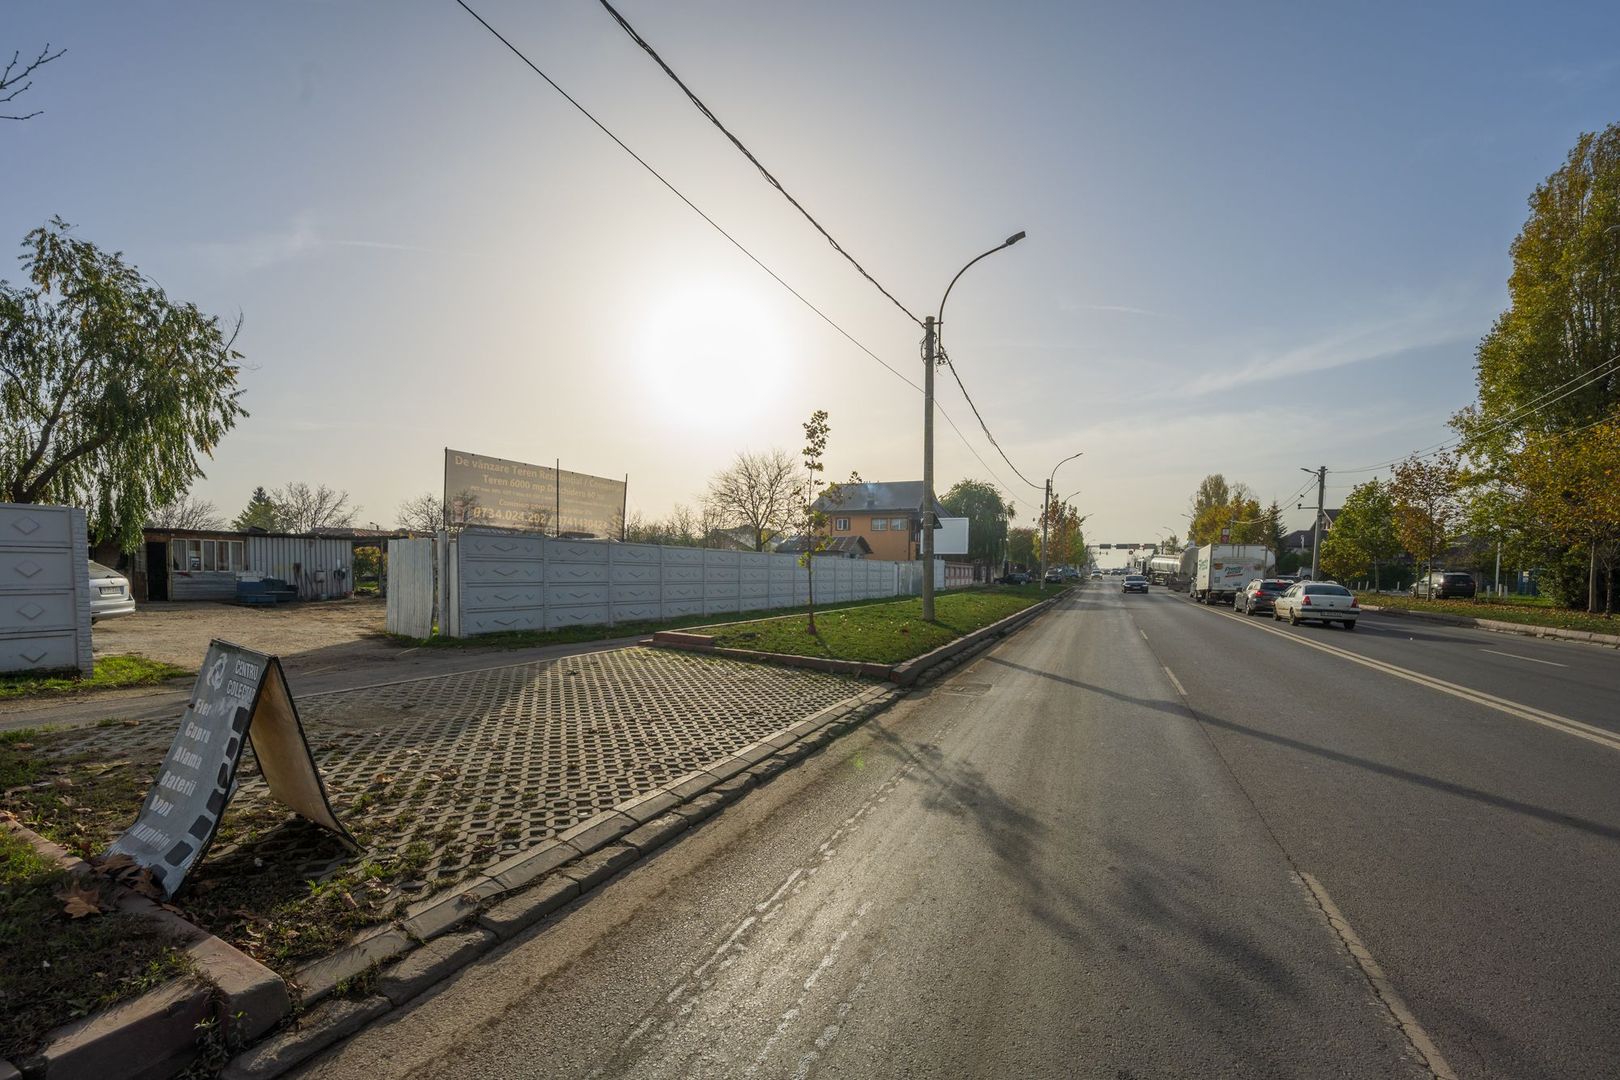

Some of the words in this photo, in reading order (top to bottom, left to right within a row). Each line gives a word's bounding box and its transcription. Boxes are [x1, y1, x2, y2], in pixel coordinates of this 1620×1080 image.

[455, 455, 470, 467] De
[482, 474, 508, 486] Teren
[235, 660, 258, 680] CENTRU
[194, 698, 212, 716] Fier
[185, 721, 211, 743] Cupru
[160, 770, 197, 797] Baterii
